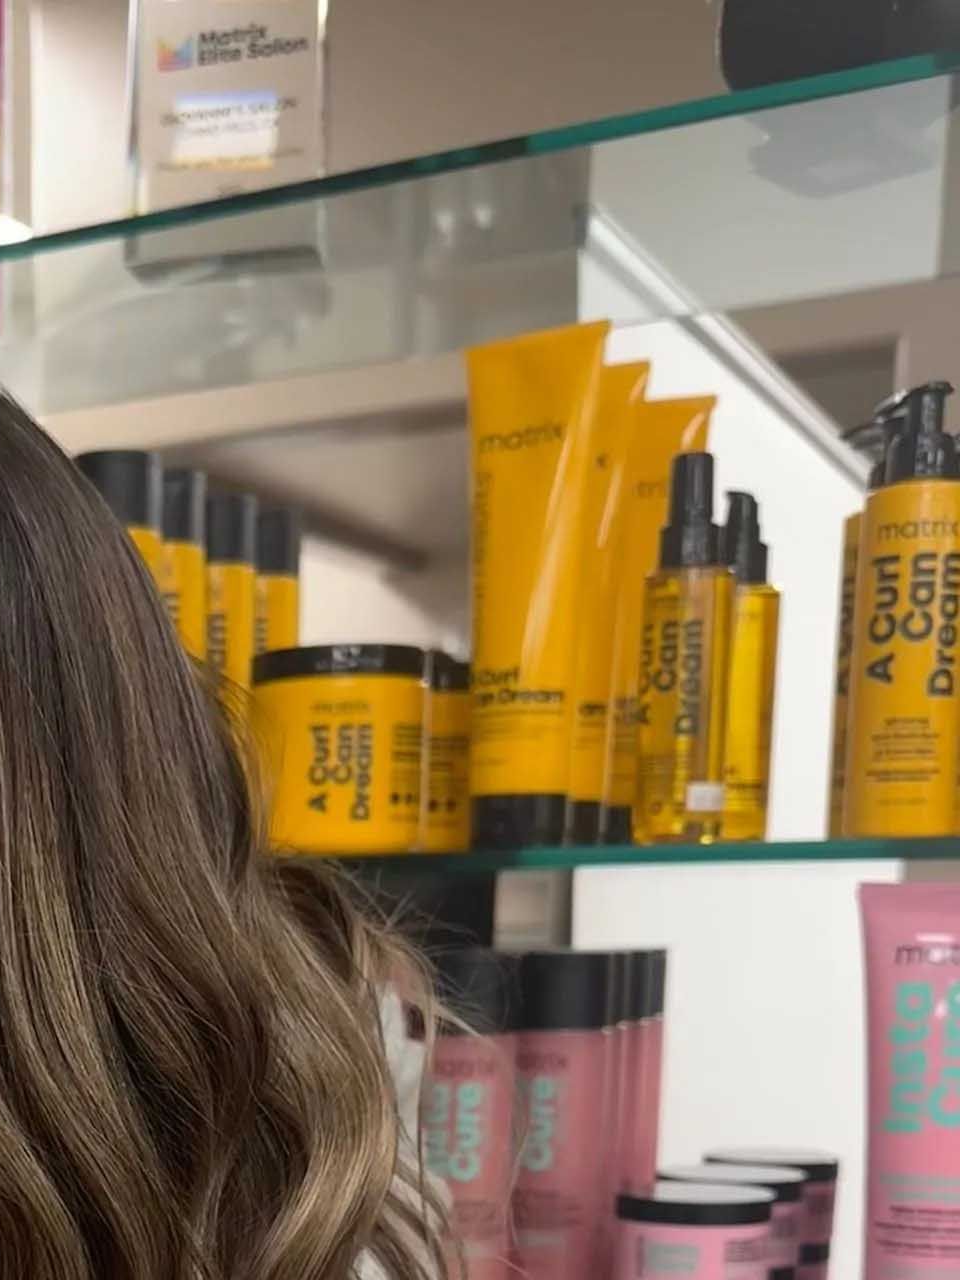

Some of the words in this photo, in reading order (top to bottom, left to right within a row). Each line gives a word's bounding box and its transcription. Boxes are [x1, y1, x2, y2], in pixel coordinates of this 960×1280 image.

[199, 22, 268, 46] Matrix
[247, 36, 309, 59] Salon
[479, 421, 563, 453] matrix
[868, 554, 901, 645] Curl
[900, 553, 938, 643] Can
[927, 553, 960, 696] Dream
[653, 619, 679, 692] Can
[674, 619, 703, 736] Dream
[865, 653, 895, 684] A
[309, 725, 331, 786] Curl
[330, 725, 353, 785] Can
[352, 724, 374, 821] Dream
[308, 794, 327, 813] A
[882, 982, 934, 1134] Insta
[448, 1082, 483, 1181] Cure
